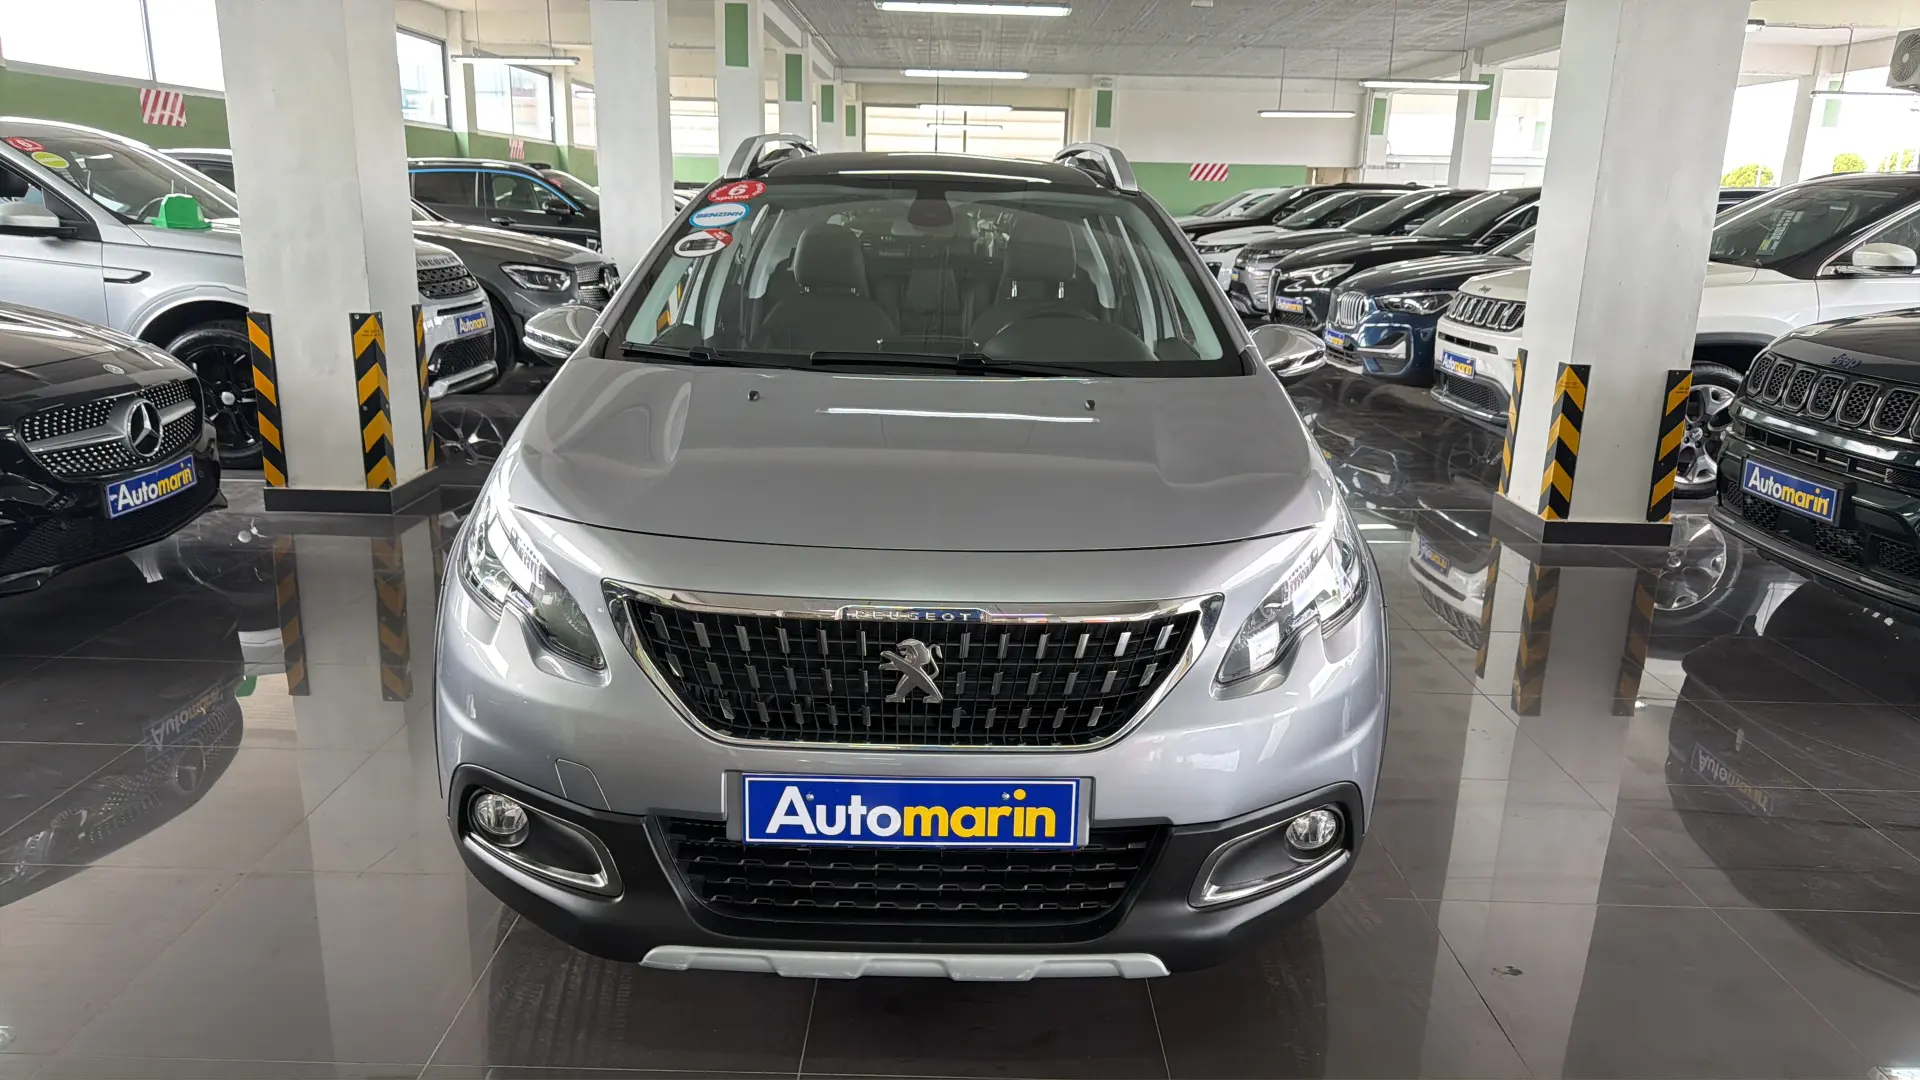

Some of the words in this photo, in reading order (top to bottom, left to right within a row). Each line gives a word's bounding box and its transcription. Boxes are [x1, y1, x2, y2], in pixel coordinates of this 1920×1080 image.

[728, 184, 748, 196] 6
[118, 462, 192, 511] Automarin
[1748, 466, 1830, 516] Automarin
[855, 610, 971, 621] PEUGEOT
[765, 786, 1056, 838] Automarin
